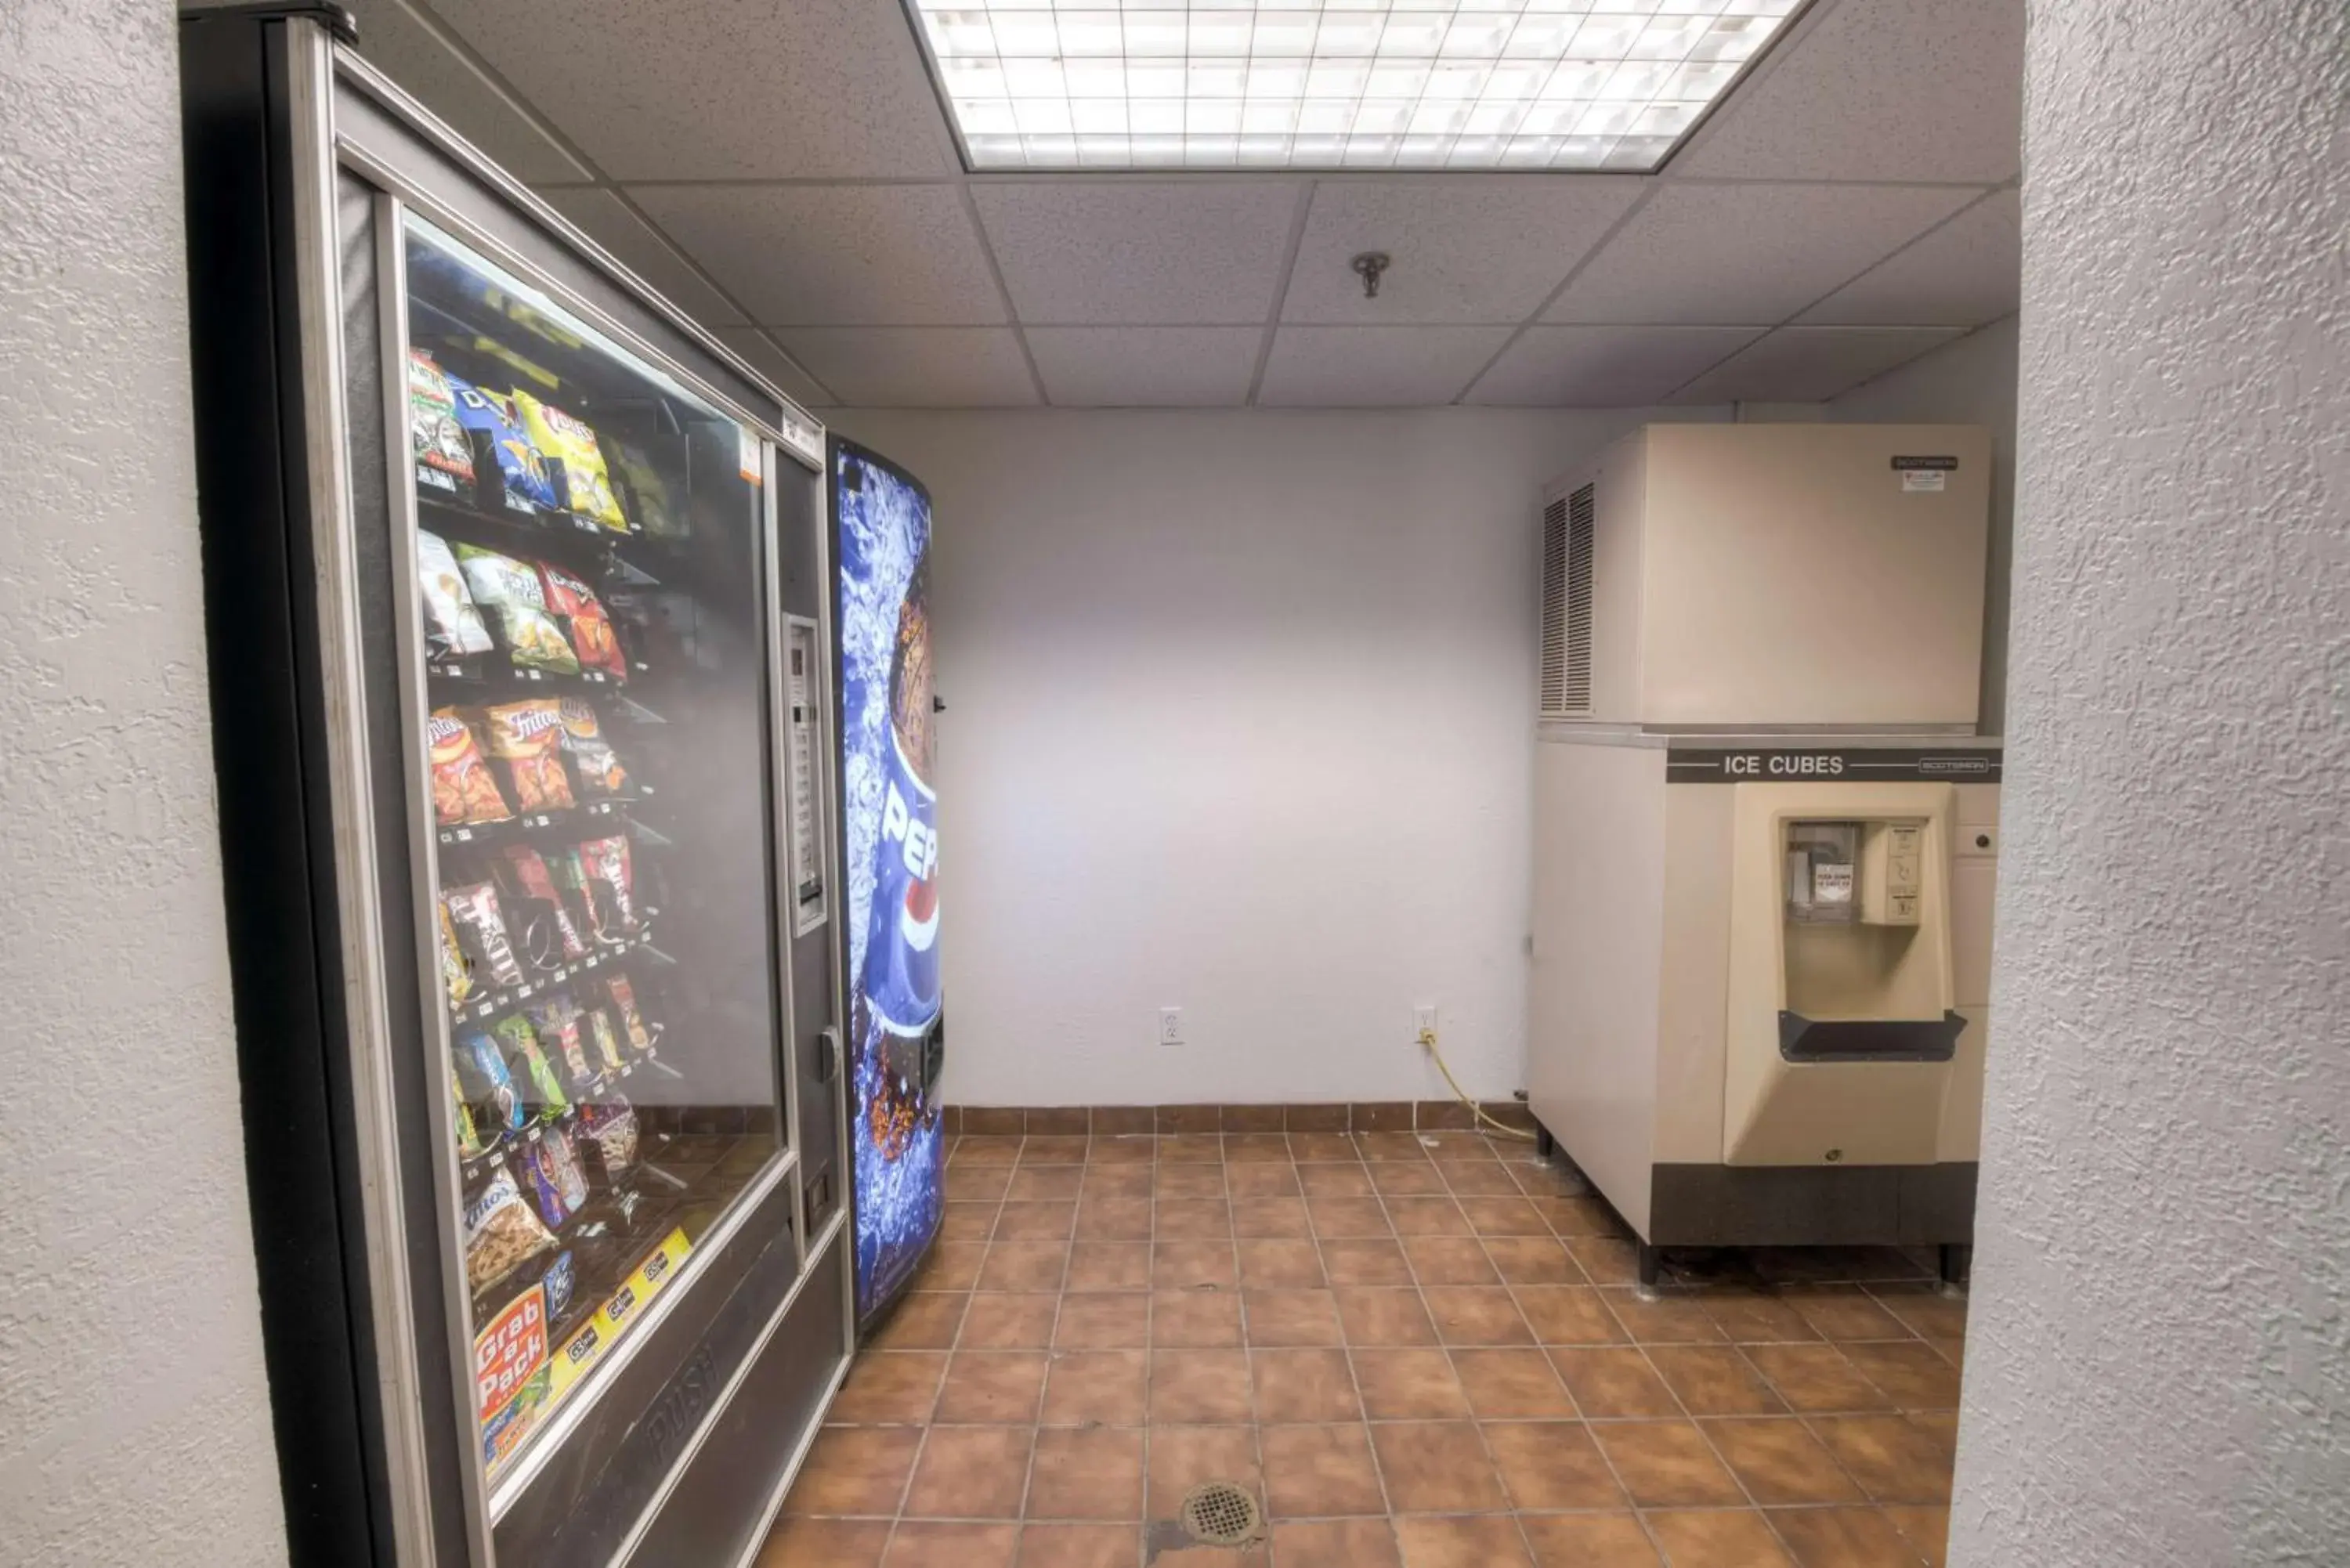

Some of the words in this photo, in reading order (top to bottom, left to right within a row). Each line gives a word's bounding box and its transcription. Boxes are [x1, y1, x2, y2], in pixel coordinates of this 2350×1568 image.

[1724, 756, 1761, 774] ICE
[1769, 756, 1843, 775] CUBES
[882, 778, 938, 880] PEP
[477, 1299, 540, 1375] Grab
[479, 1333, 541, 1409] Pack
[504, 1338, 518, 1363] a
[647, 1342, 721, 1466] PUSH
